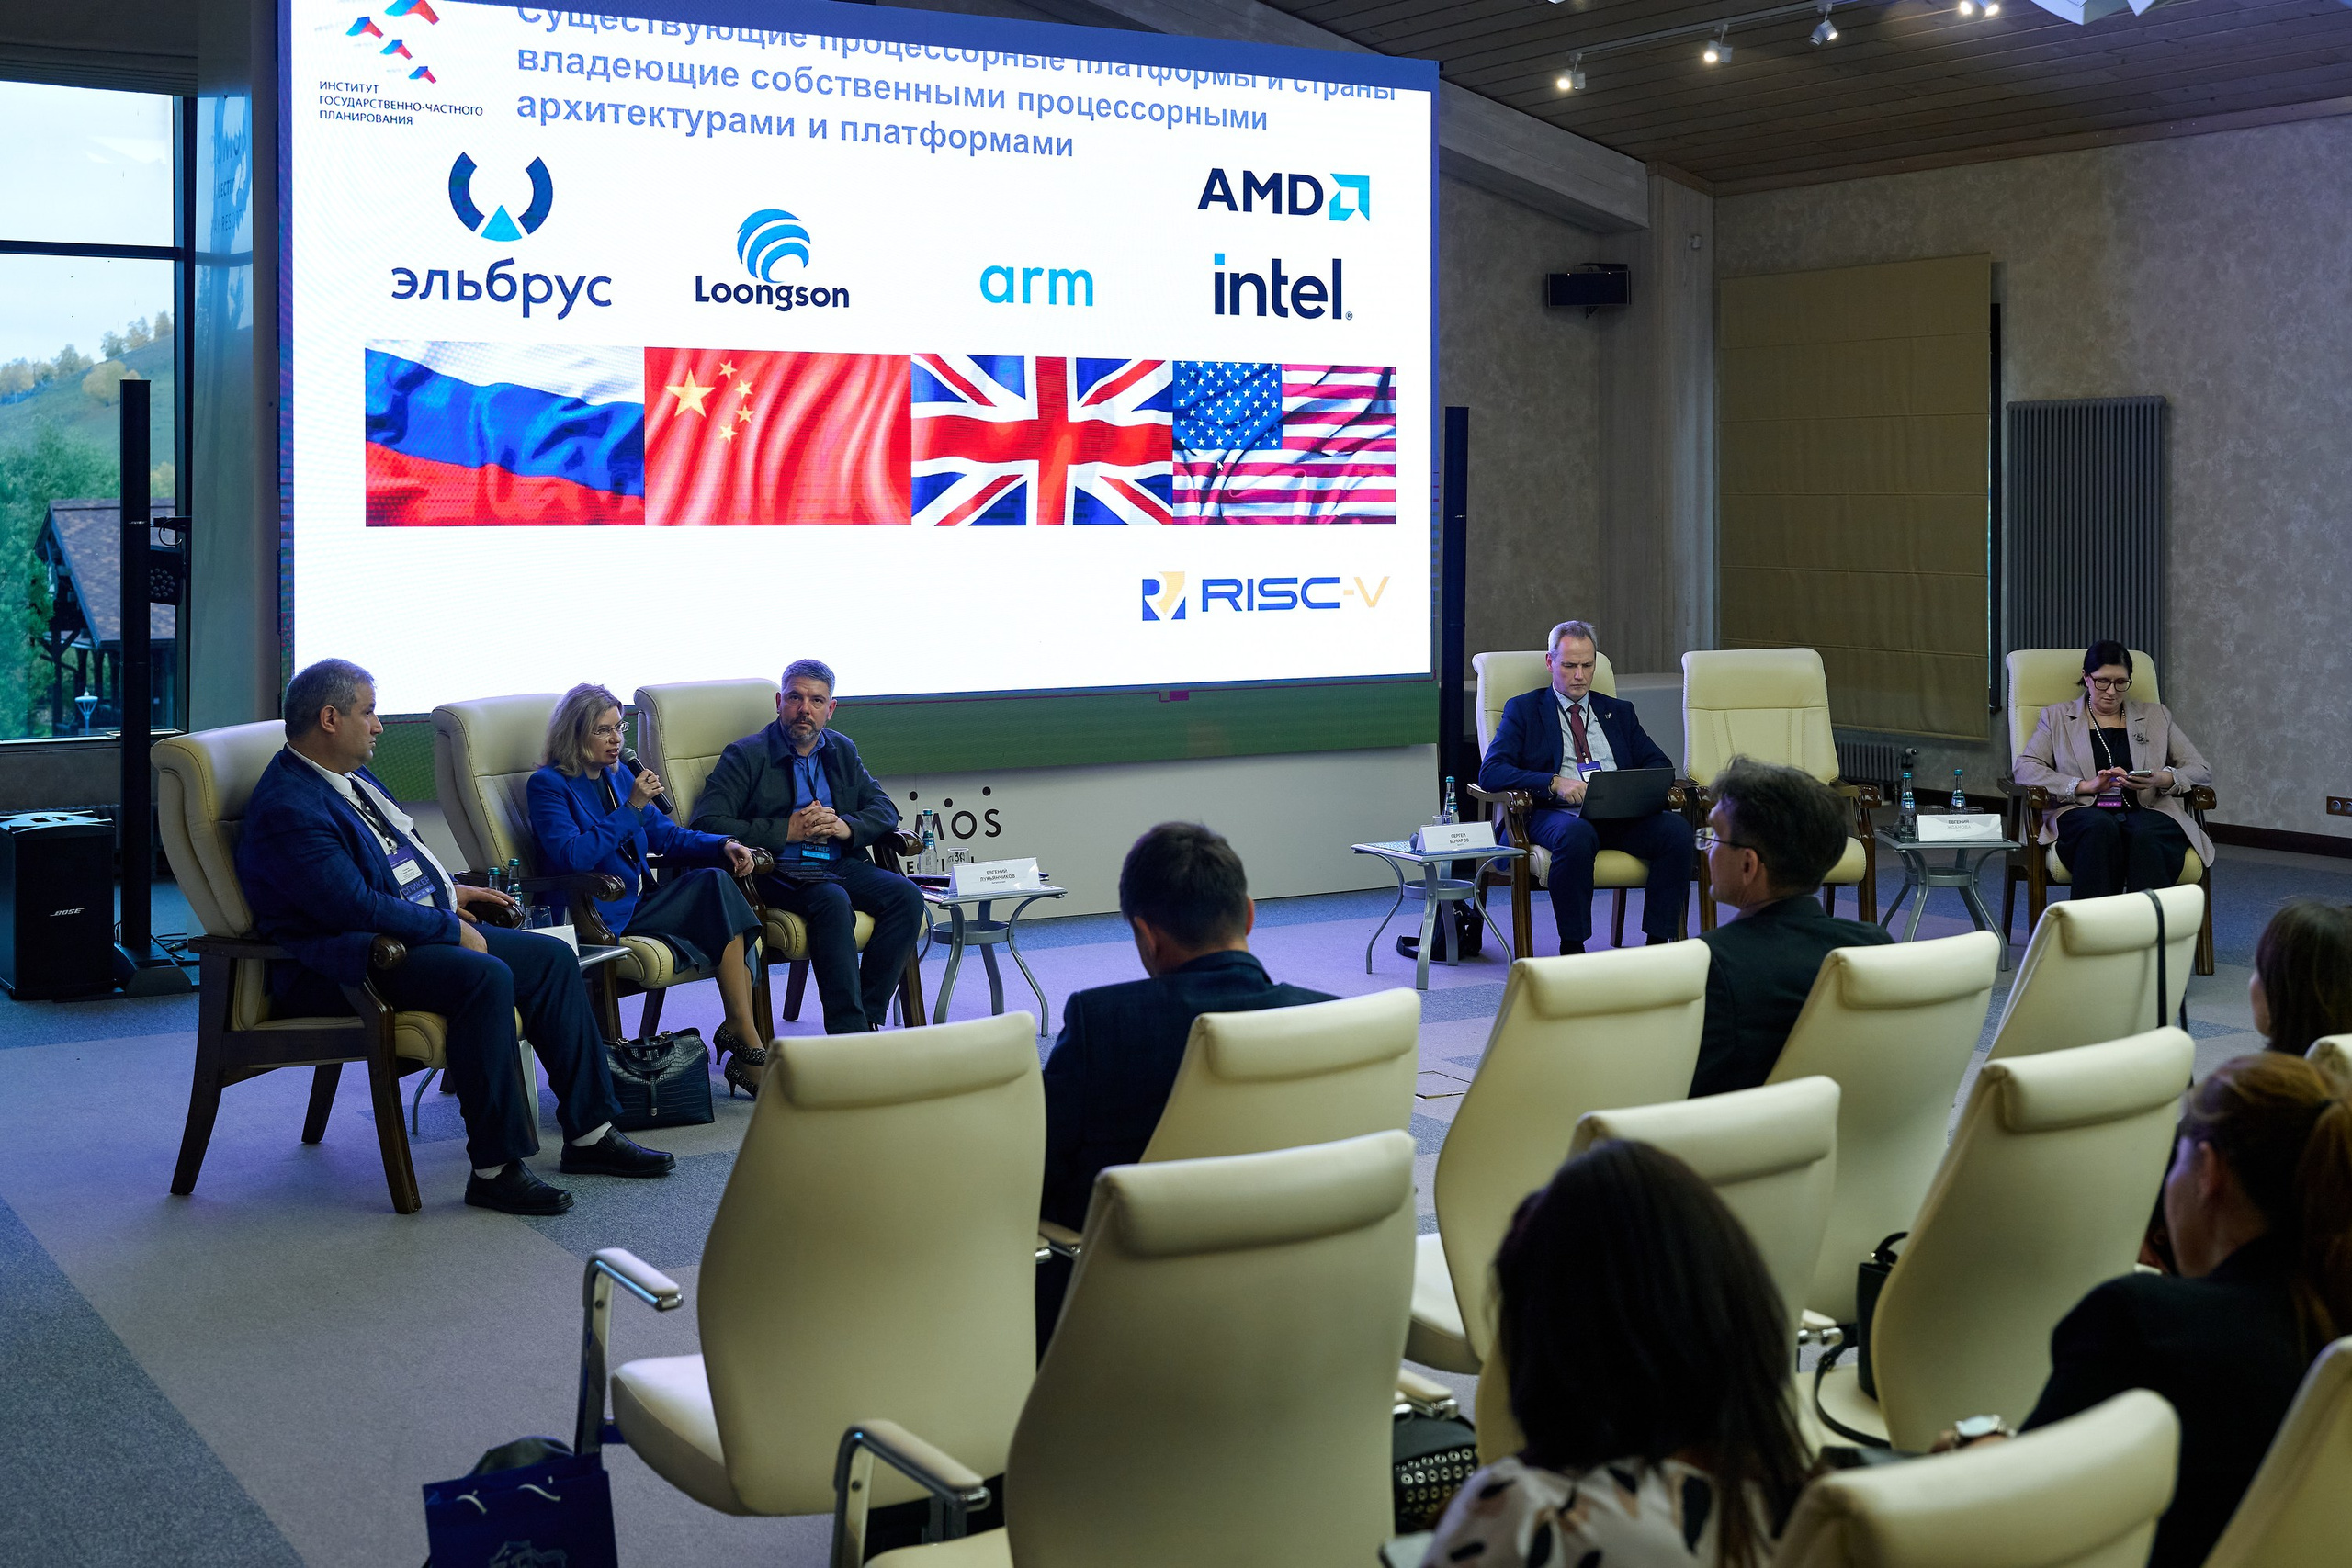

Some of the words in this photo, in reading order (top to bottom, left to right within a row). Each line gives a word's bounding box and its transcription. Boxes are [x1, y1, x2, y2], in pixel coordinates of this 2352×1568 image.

[517, 6, 808, 49] Существующие
[820, 35, 1066, 72] процессорные
[1268, 76, 1283, 91] и
[319, 80, 379, 95] ИНСТИТУТ
[319, 95, 483, 117] ГОСУДАРСТВЕННО-ЧАСТНОГО
[517, 49, 740, 90] владеющие
[751, 62, 1005, 109] собственными
[1018, 91, 1267, 130] процессорными
[319, 109, 413, 126] ПЛАНИРОВАНИЯ
[516, 96, 795, 138] архитектурами
[808, 118, 828, 140] и
[841, 120, 1074, 158] платформами
[1197, 168, 1324, 217] AMD
[390, 257, 613, 321] эльбрус
[695, 275, 850, 312] Loongson
[979, 265, 1094, 307] arm
[1202, 576, 1391, 613] RISC-V
[914, 808, 1001, 841] MOS
[401, 875, 430, 896] СПИКЕР
[50, 907, 85, 917] BOSE
